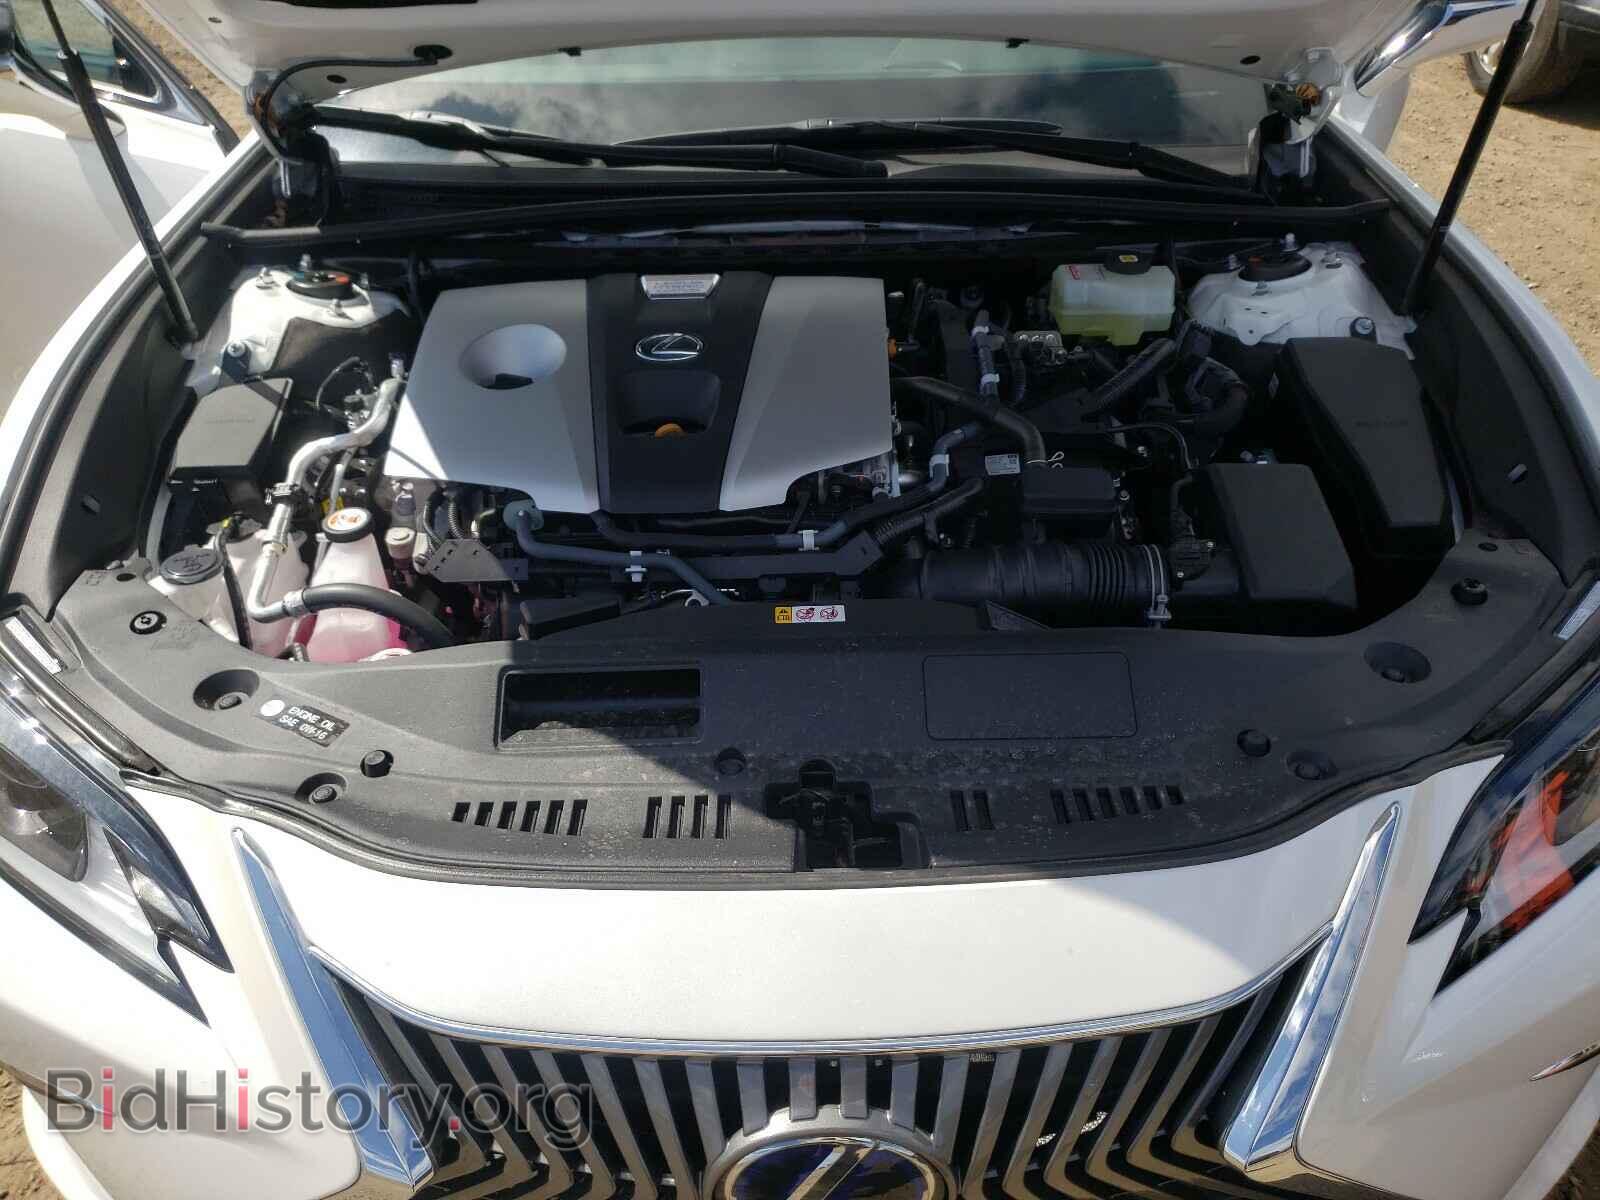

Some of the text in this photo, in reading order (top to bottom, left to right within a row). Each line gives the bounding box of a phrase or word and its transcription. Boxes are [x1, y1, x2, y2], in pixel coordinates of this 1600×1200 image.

[279, 714, 300, 727] SAE
[288, 706, 336, 732] ENGINE OIL
